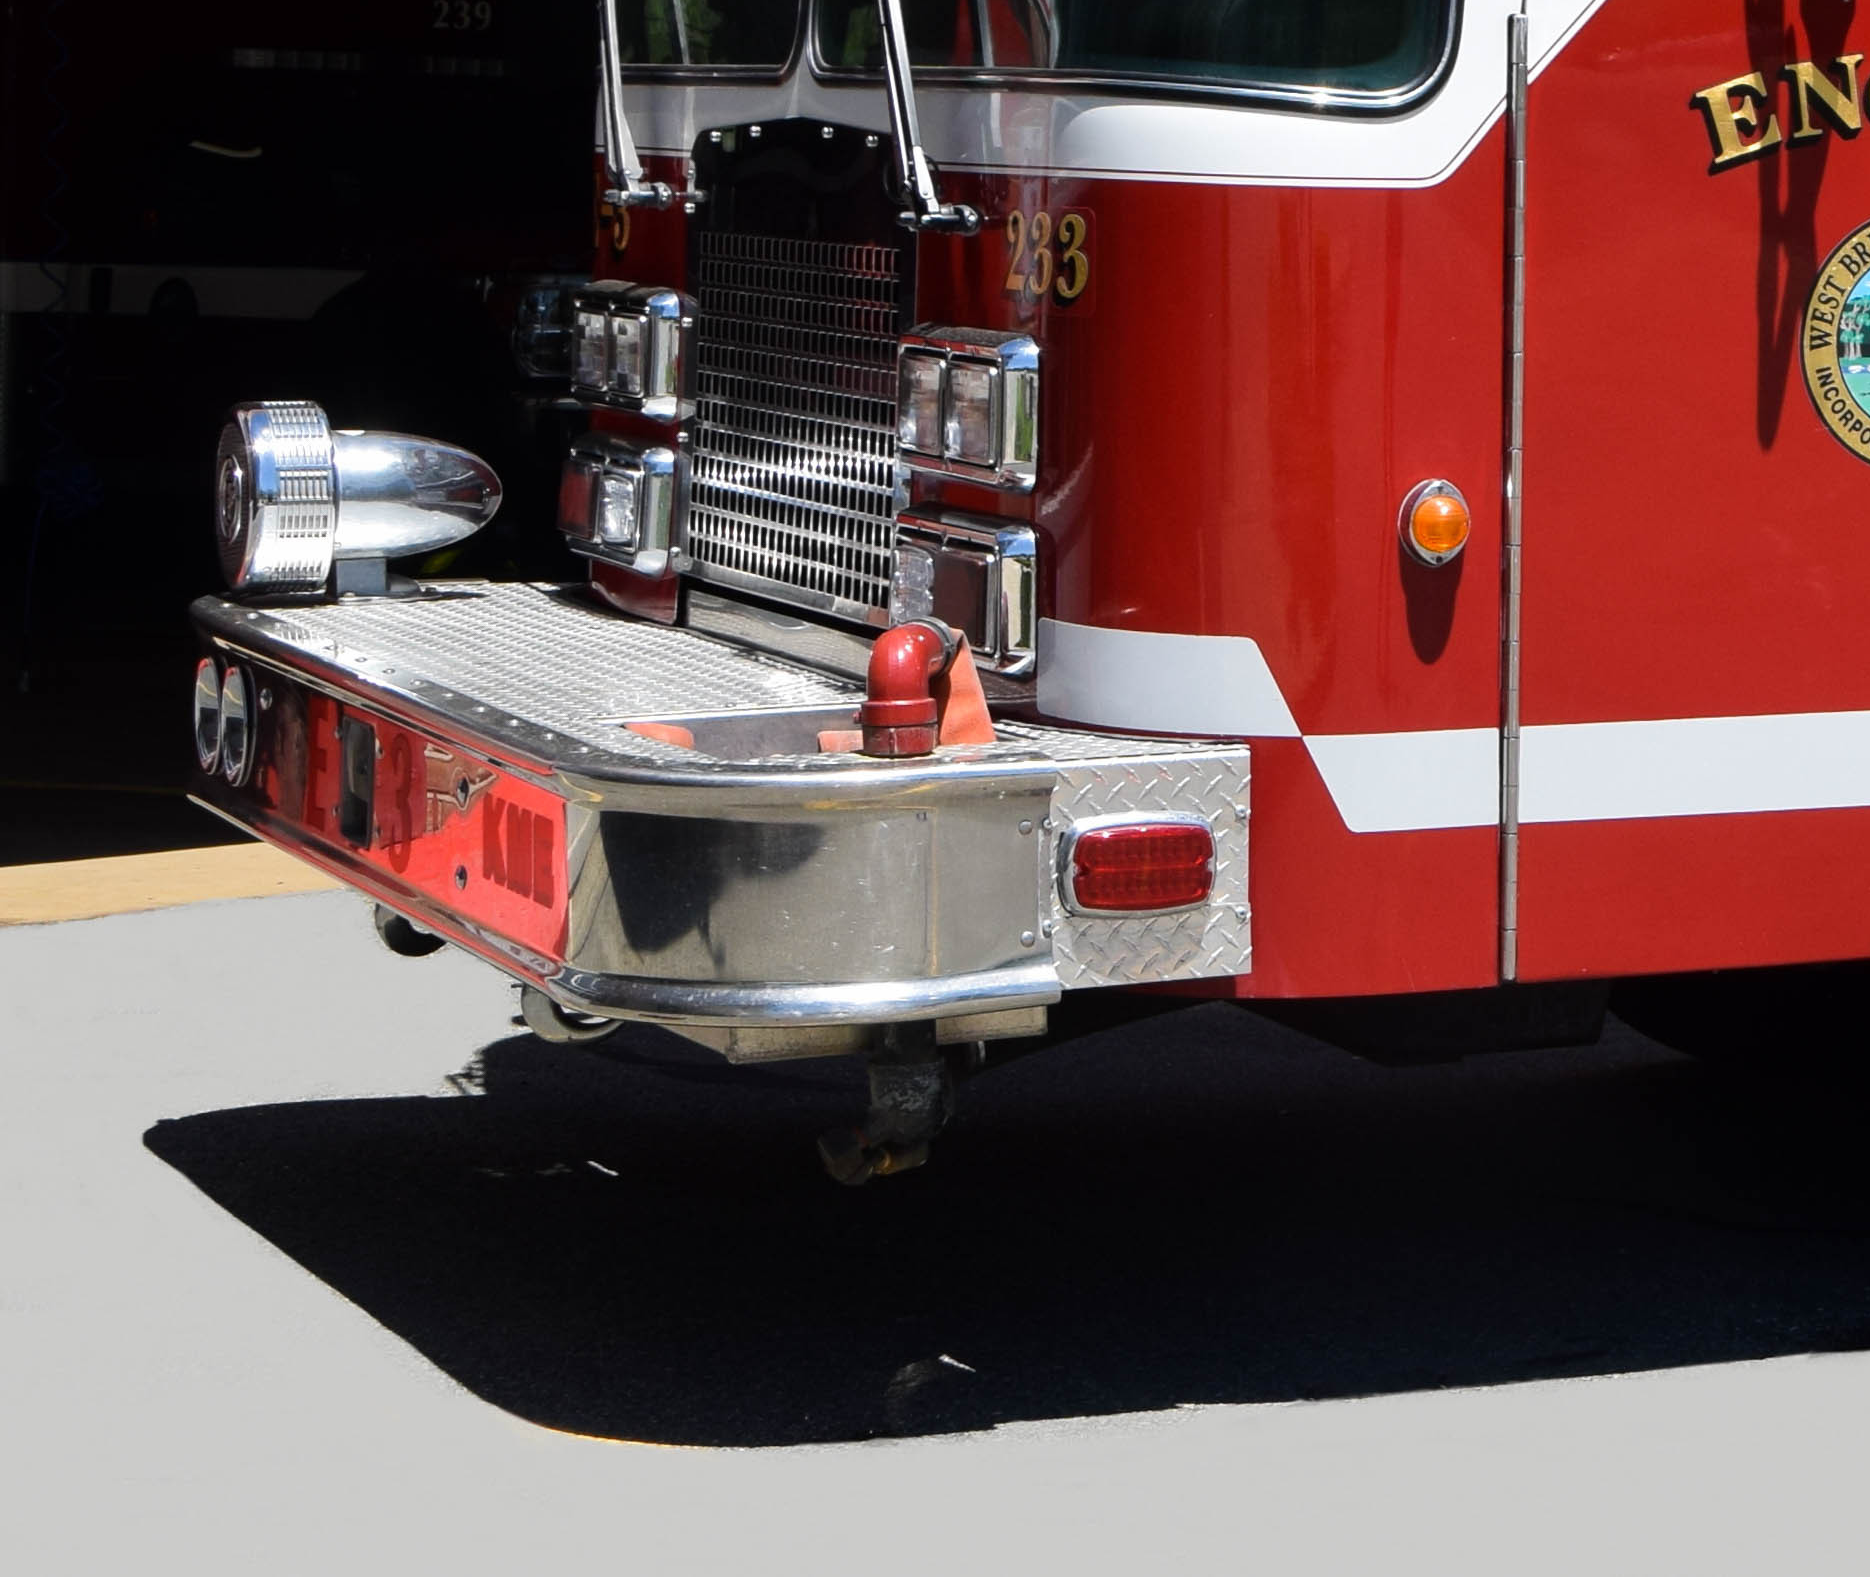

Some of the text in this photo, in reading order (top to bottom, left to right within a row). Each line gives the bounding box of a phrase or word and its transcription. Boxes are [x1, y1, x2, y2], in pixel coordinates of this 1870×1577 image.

[432, 0, 494, 31] 239
[1003, 208, 1092, 307] 233
[1809, 274, 1848, 352] WEST
[388, 732, 413, 874] 3
[481, 791, 555, 910] KME
